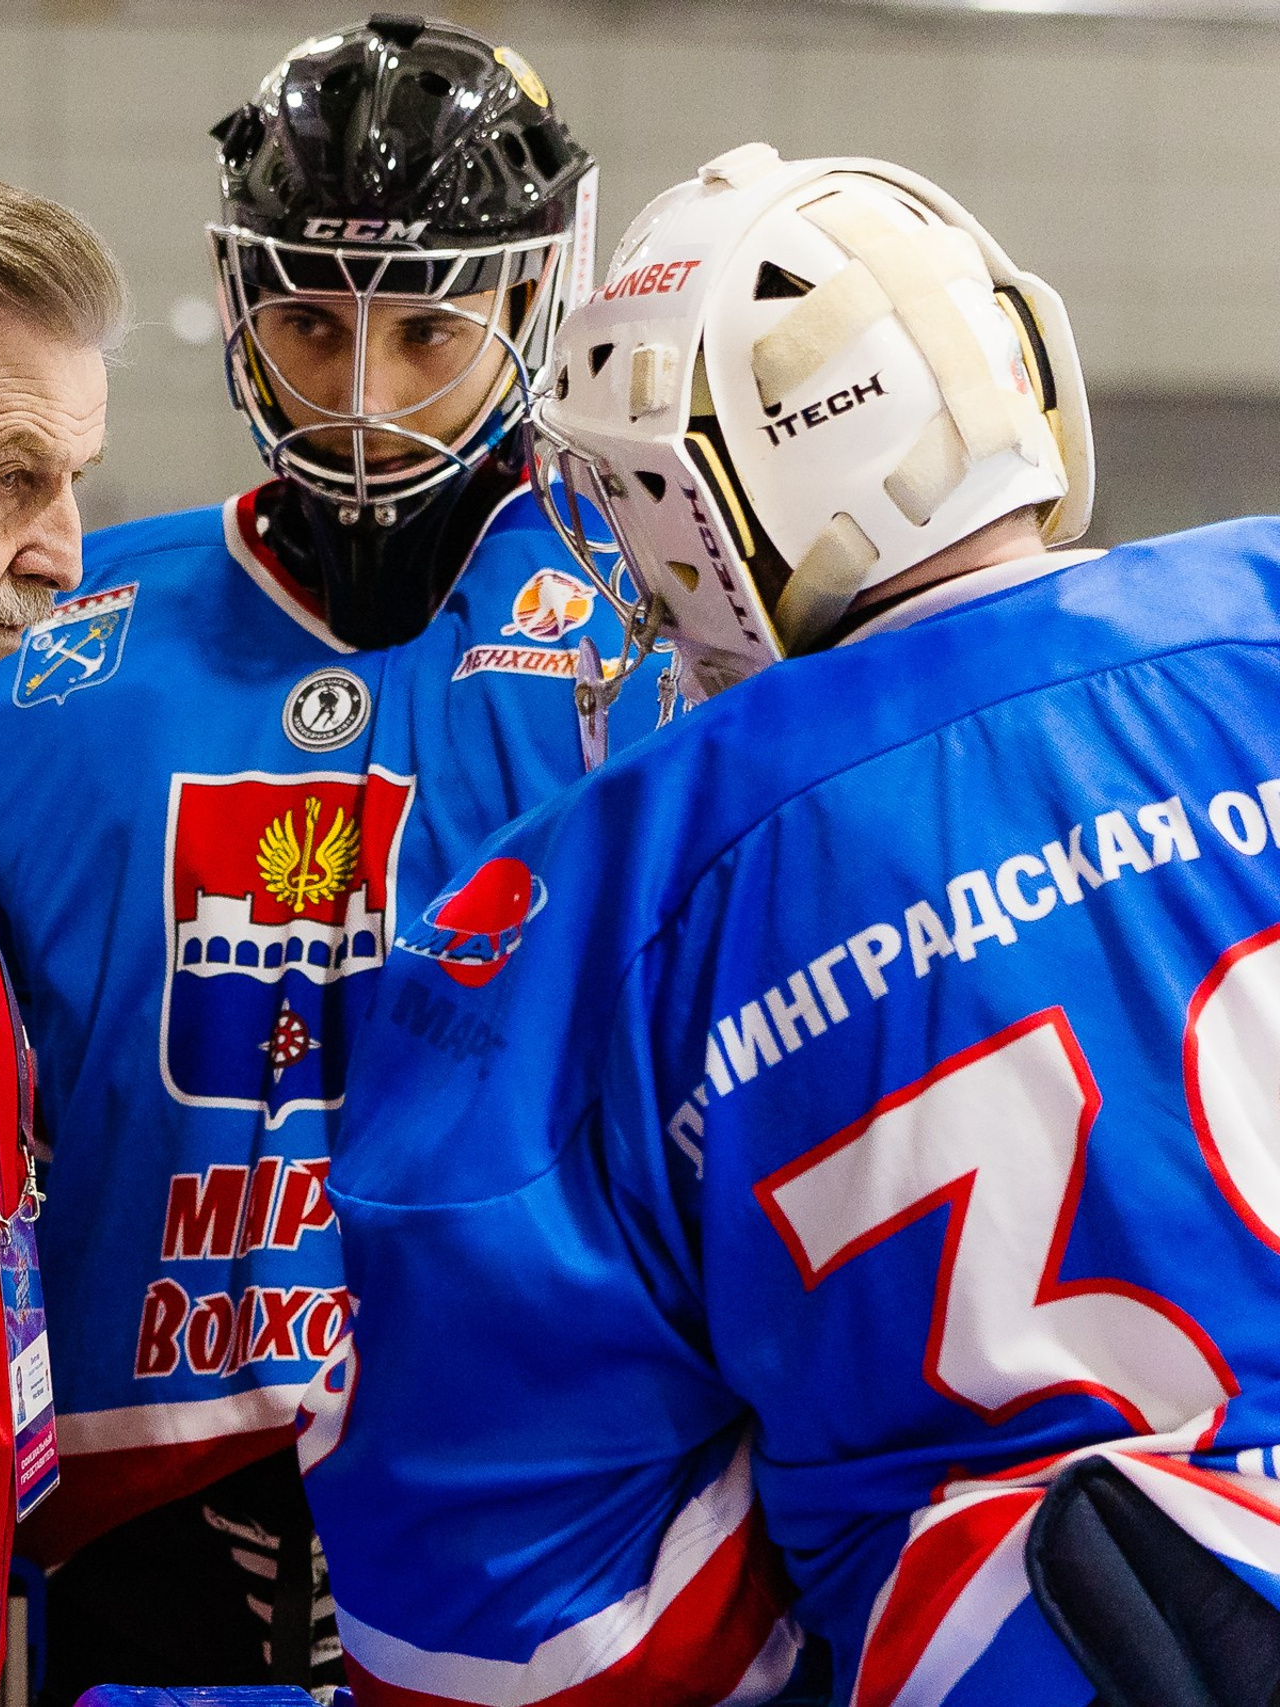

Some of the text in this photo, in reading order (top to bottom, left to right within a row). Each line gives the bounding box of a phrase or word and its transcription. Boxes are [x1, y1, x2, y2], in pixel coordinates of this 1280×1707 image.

[303, 217, 431, 241] CCM
[757, 369, 889, 448] ITECH
[456, 649, 578, 678] ЛЕНХОКК
